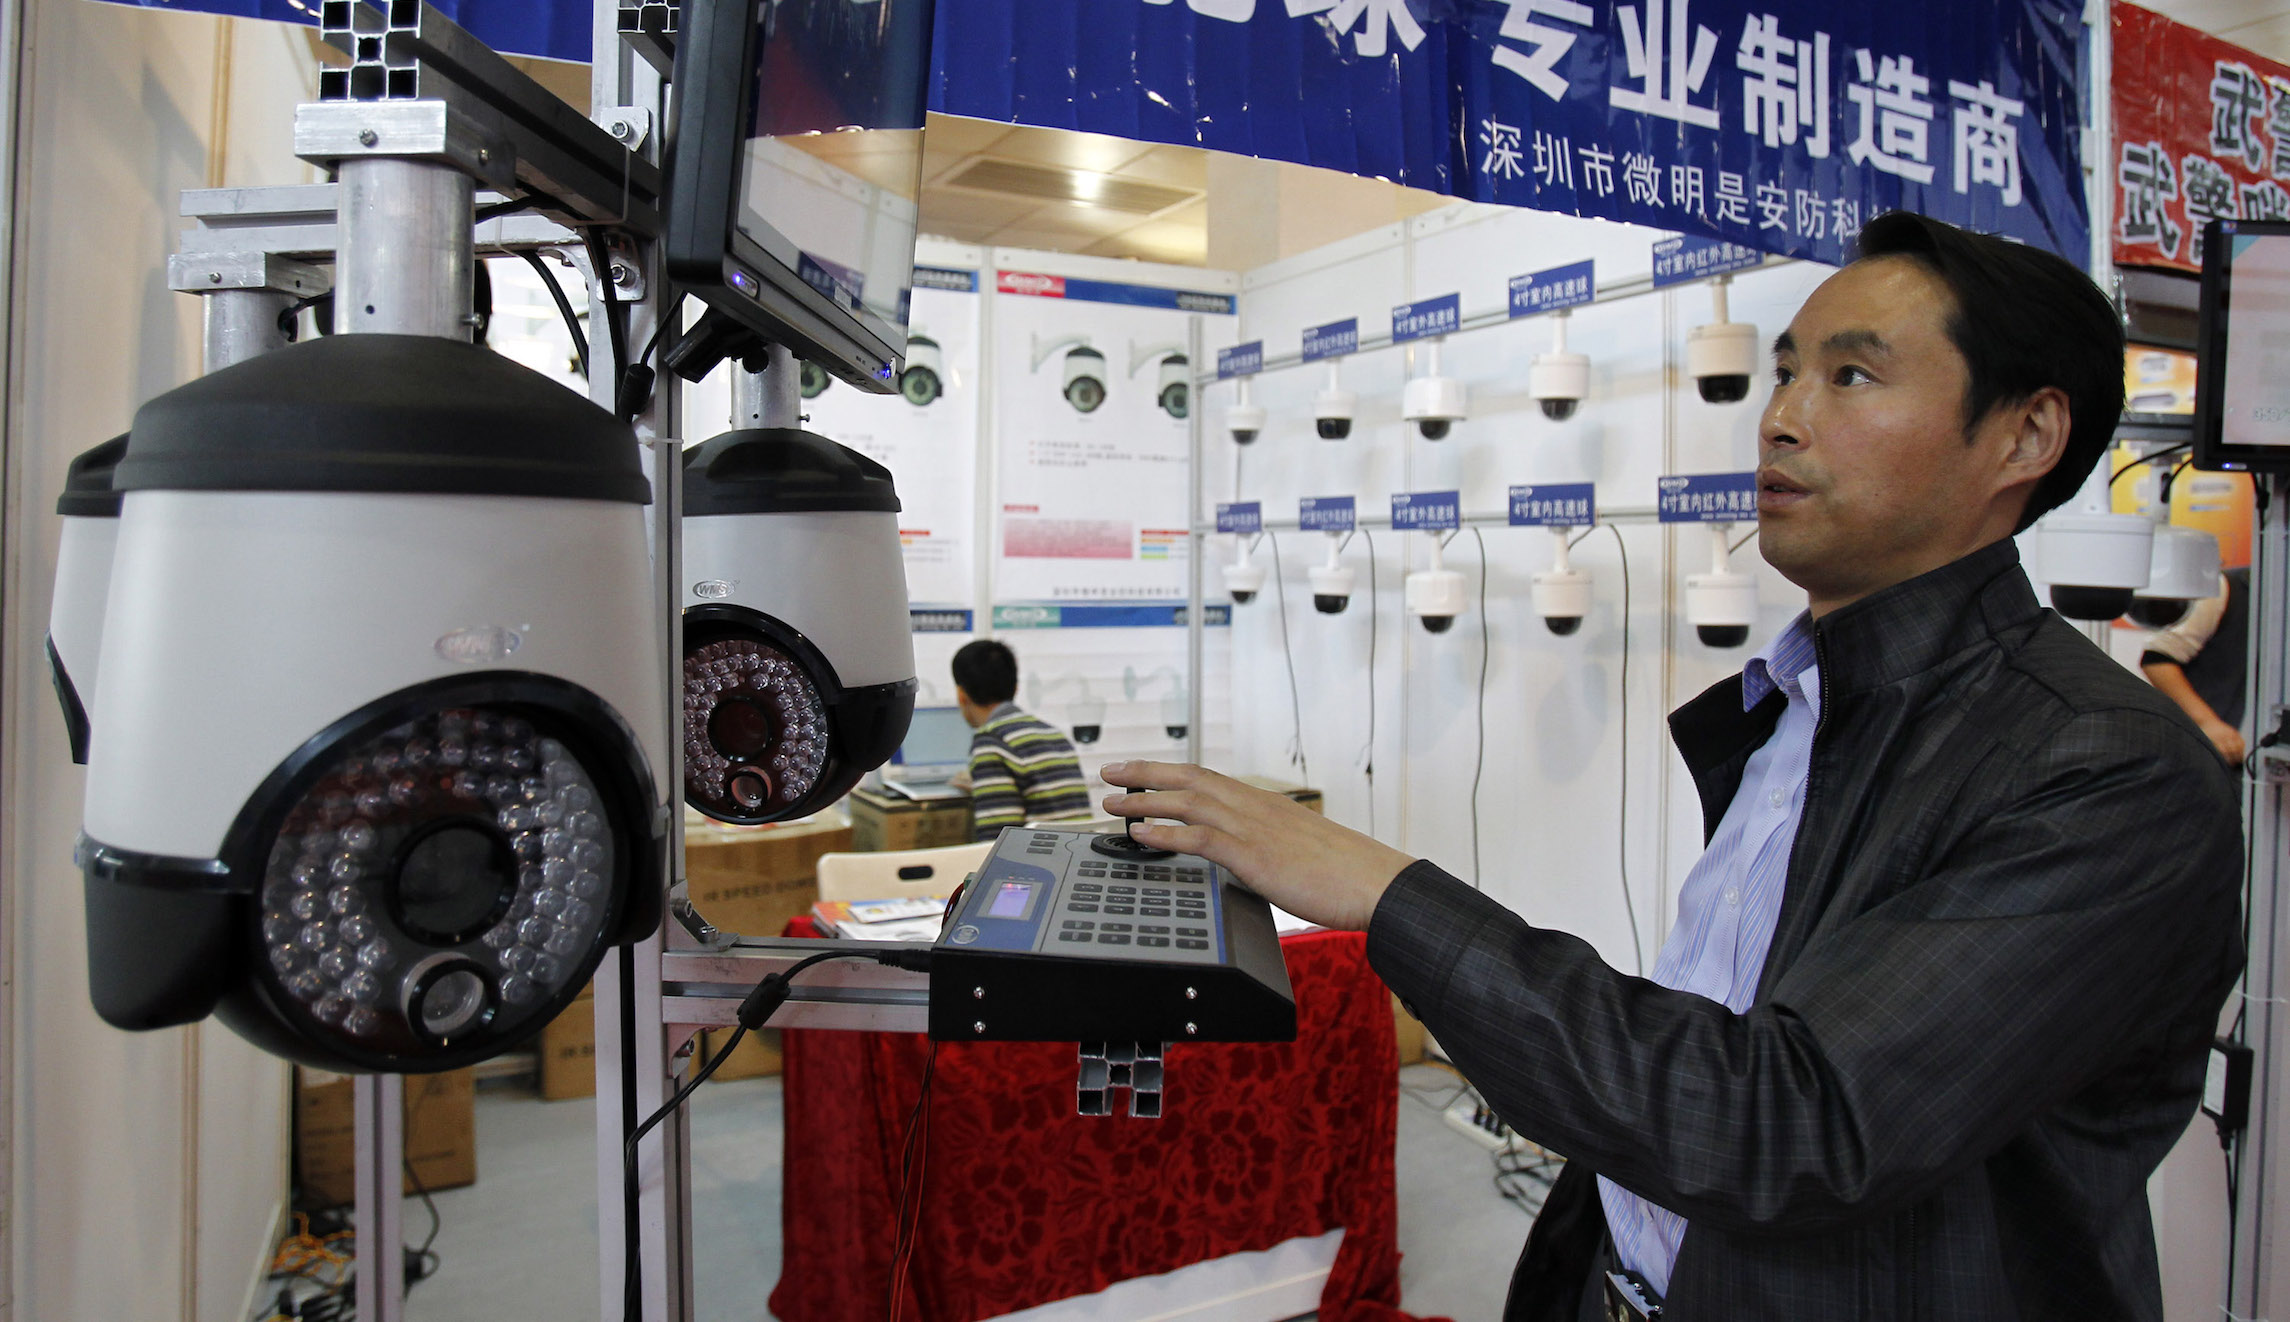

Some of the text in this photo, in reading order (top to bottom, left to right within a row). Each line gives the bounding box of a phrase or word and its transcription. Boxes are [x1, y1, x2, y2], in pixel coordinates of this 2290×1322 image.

[1479, 117, 2025, 246] 深圳市微明是安防科
